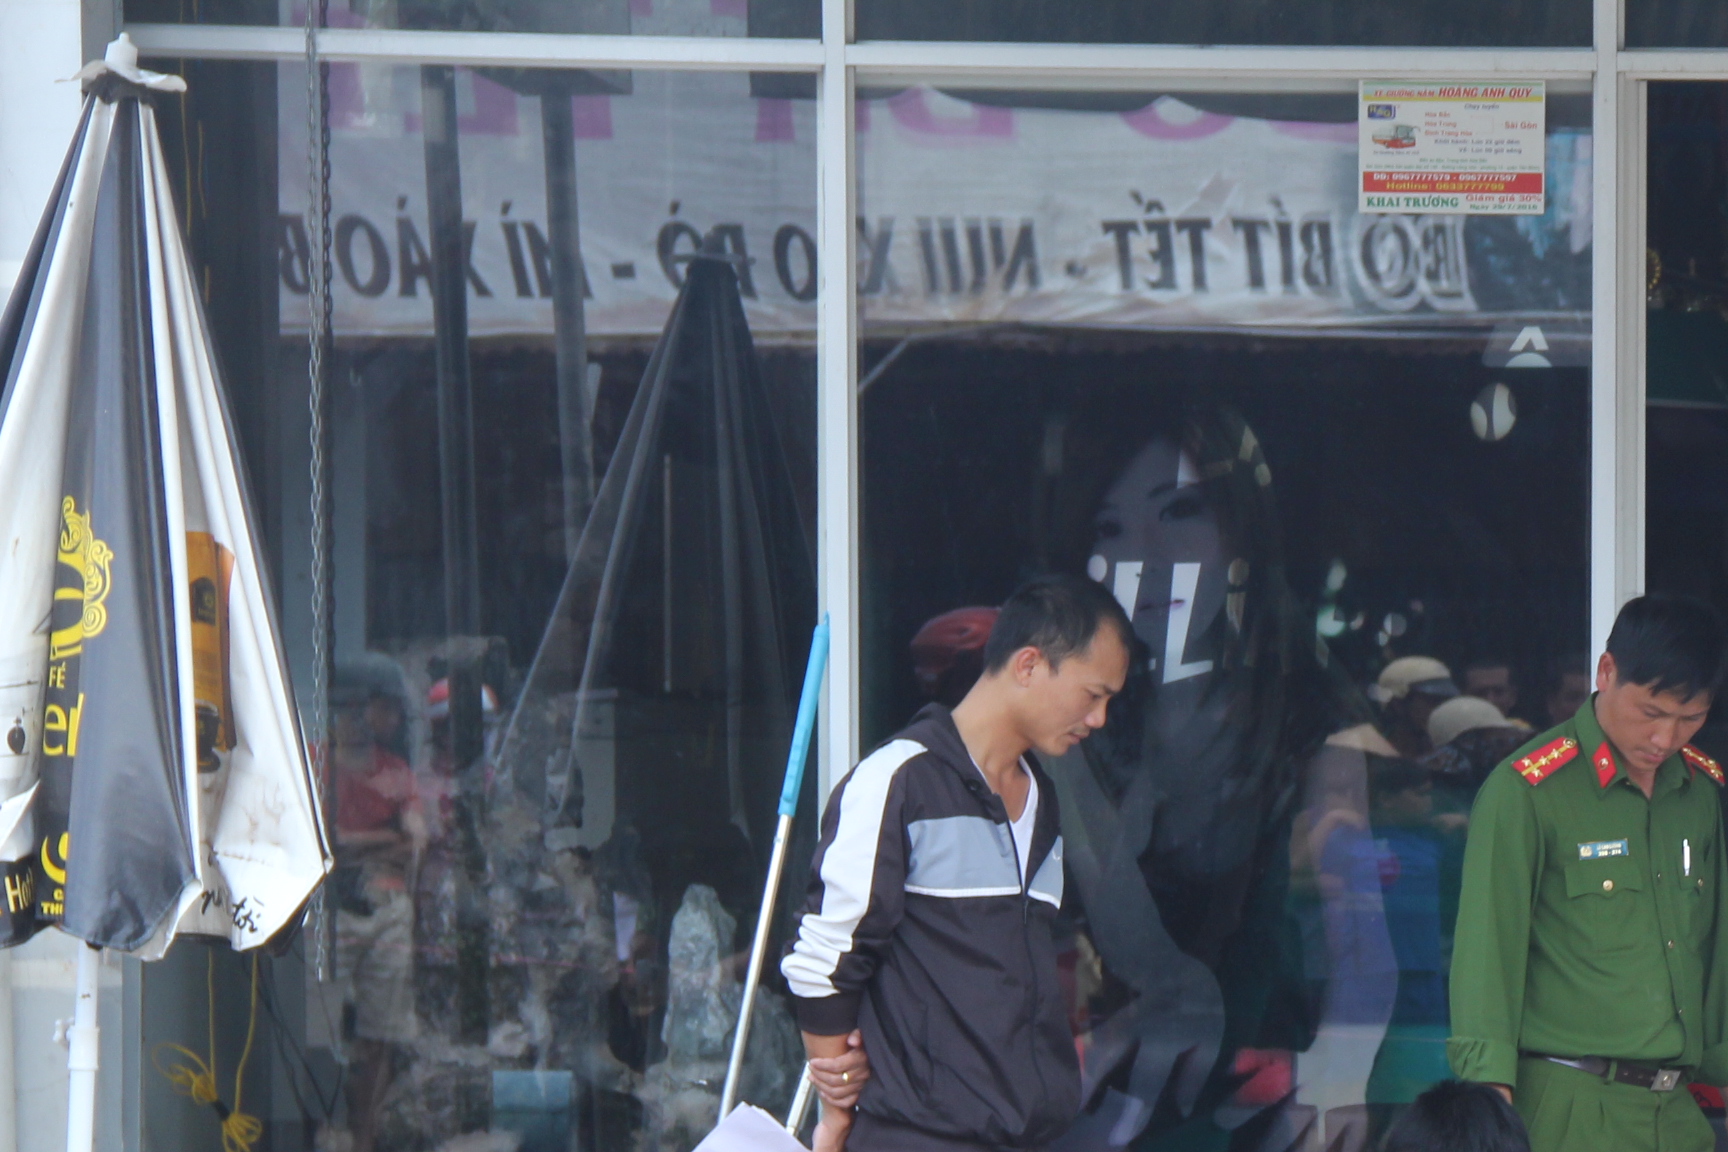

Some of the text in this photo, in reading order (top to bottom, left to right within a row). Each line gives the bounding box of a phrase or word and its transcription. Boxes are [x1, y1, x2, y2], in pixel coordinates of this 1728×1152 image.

[1438, 85, 1479, 98] HOÀNG
[1481, 87, 1506, 98] ANH
[1366, 194, 1459, 208] KHAI TRƯƠNG
